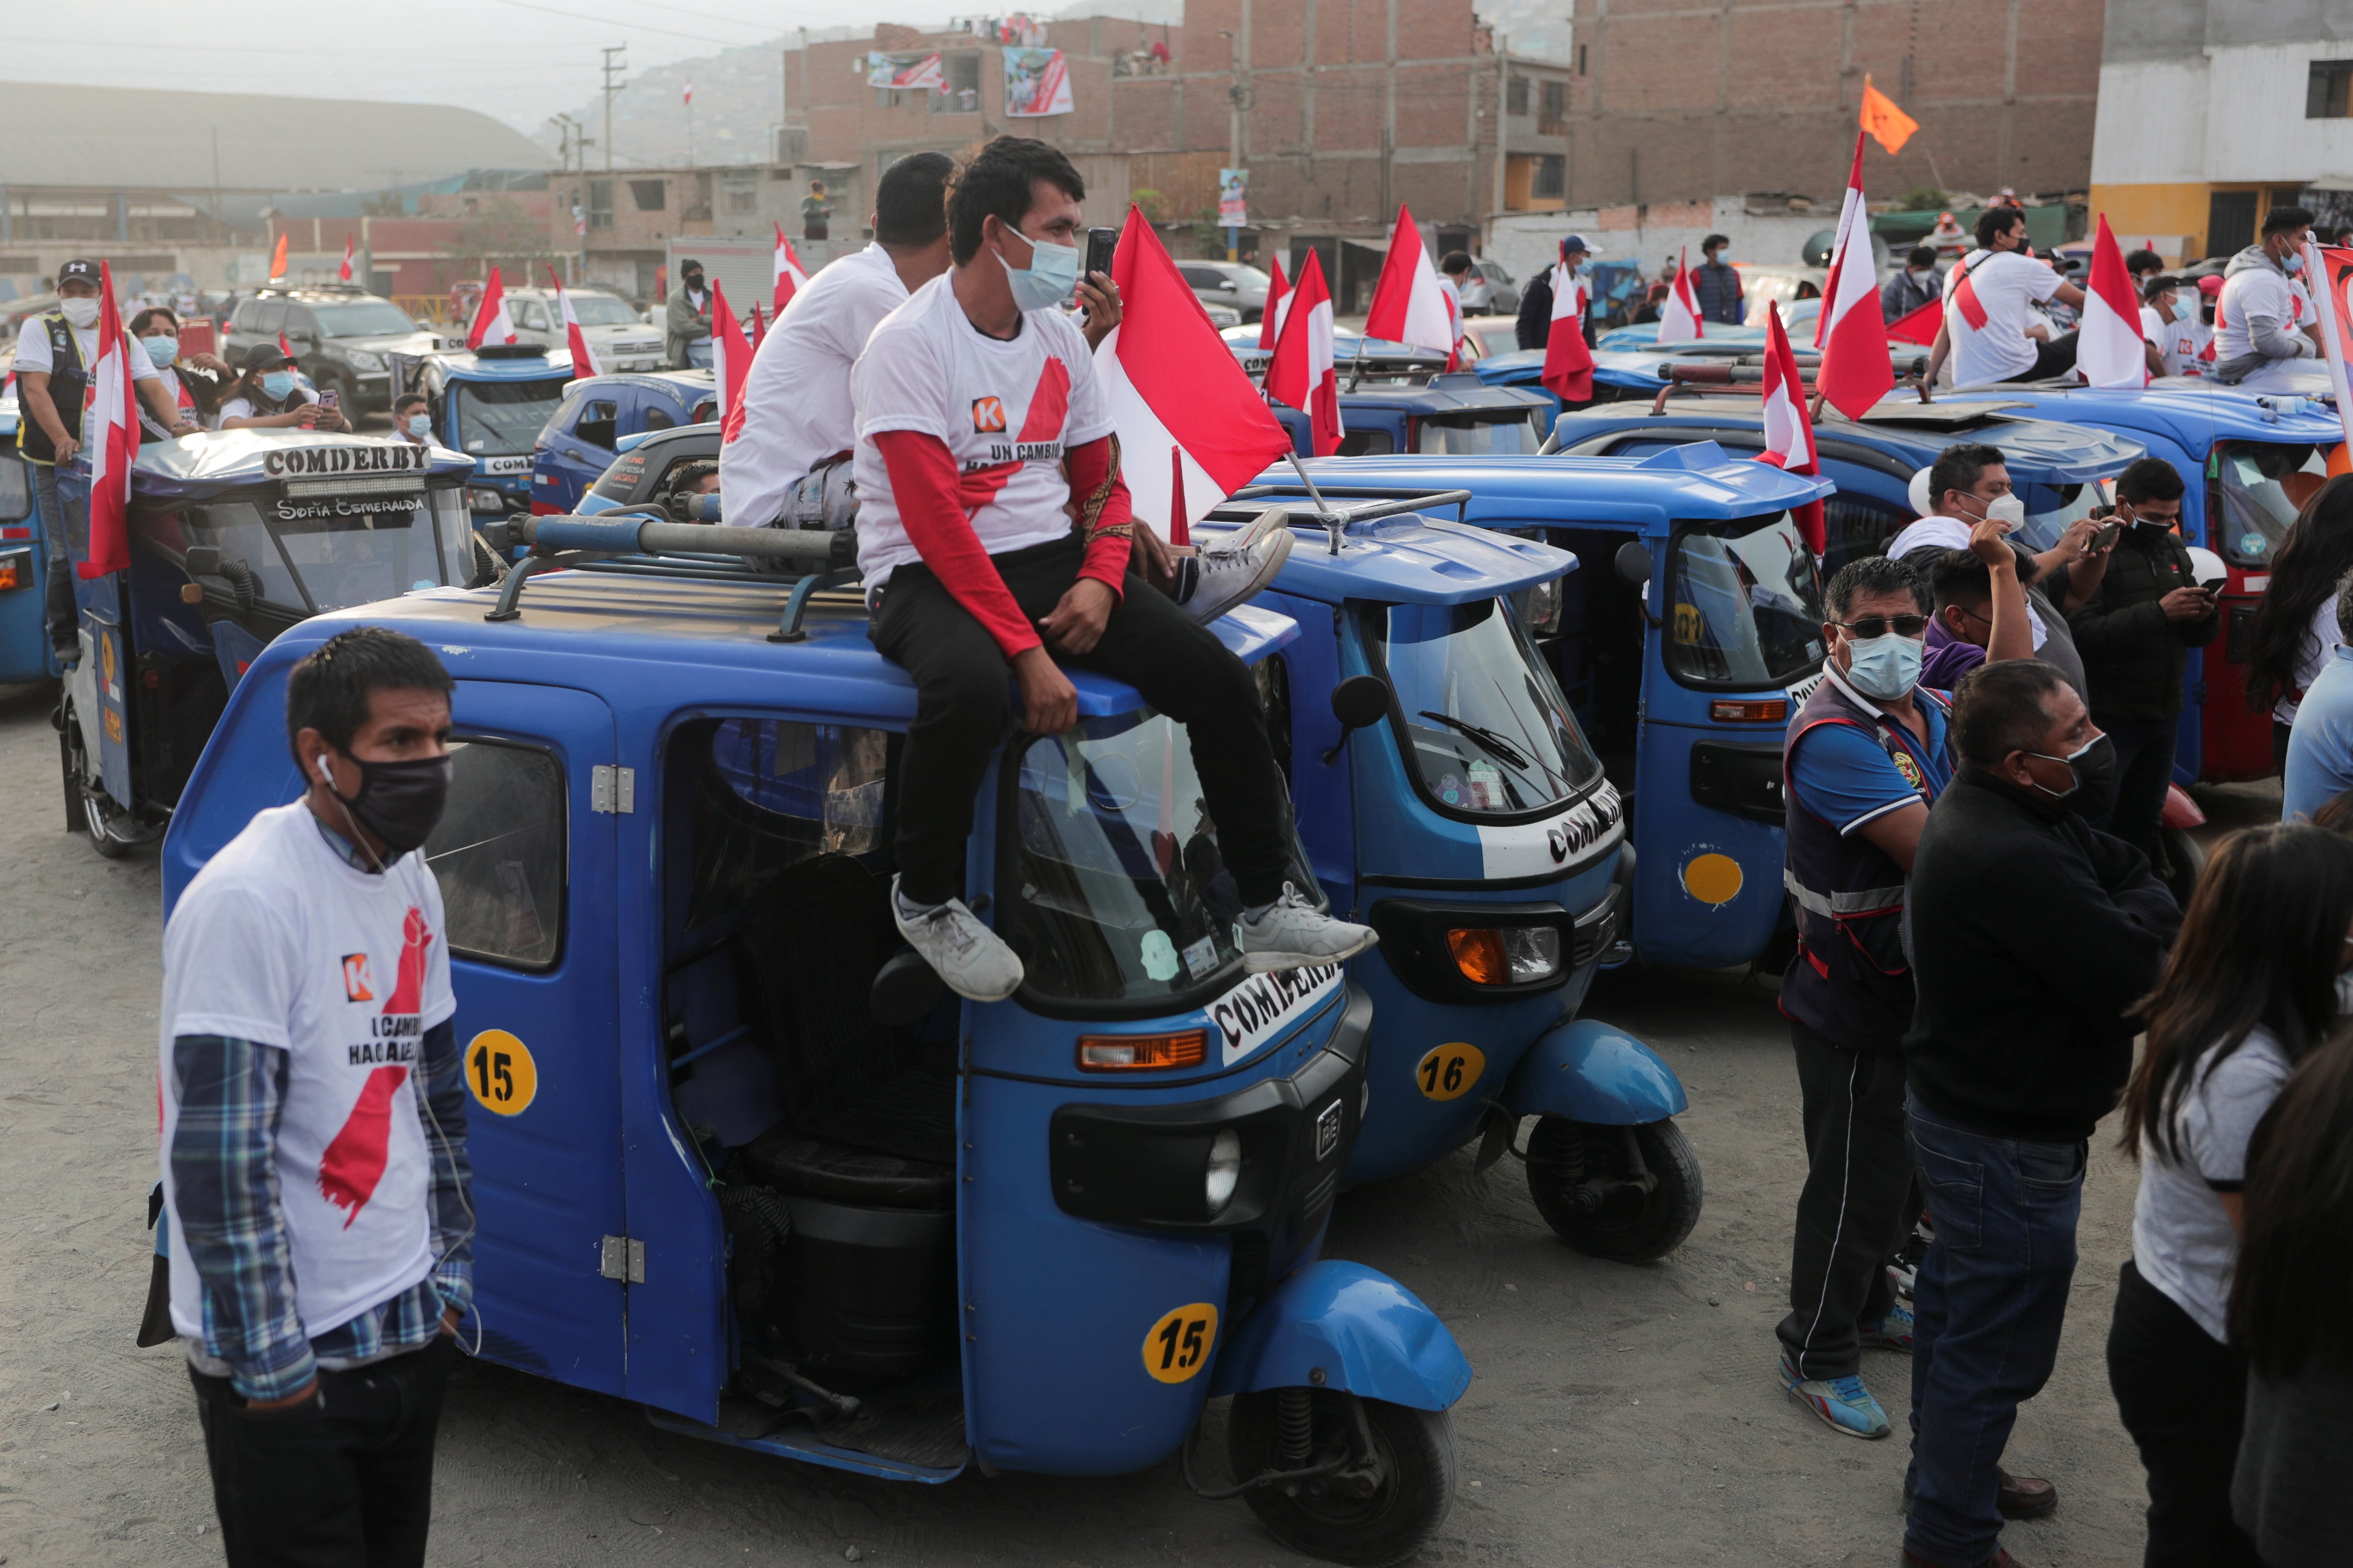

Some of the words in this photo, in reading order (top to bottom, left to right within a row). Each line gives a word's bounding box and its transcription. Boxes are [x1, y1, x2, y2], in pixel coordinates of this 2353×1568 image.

[978, 401, 1002, 428] K
[266, 446, 428, 475] COMDERBY
[991, 444, 1012, 460] UN
[1016, 443, 1060, 460] CAMBIO
[346, 961, 374, 995] K
[474, 1045, 513, 1102] 15
[1423, 1055, 1466, 1092] 16
[1159, 1318, 1207, 1370] 15
